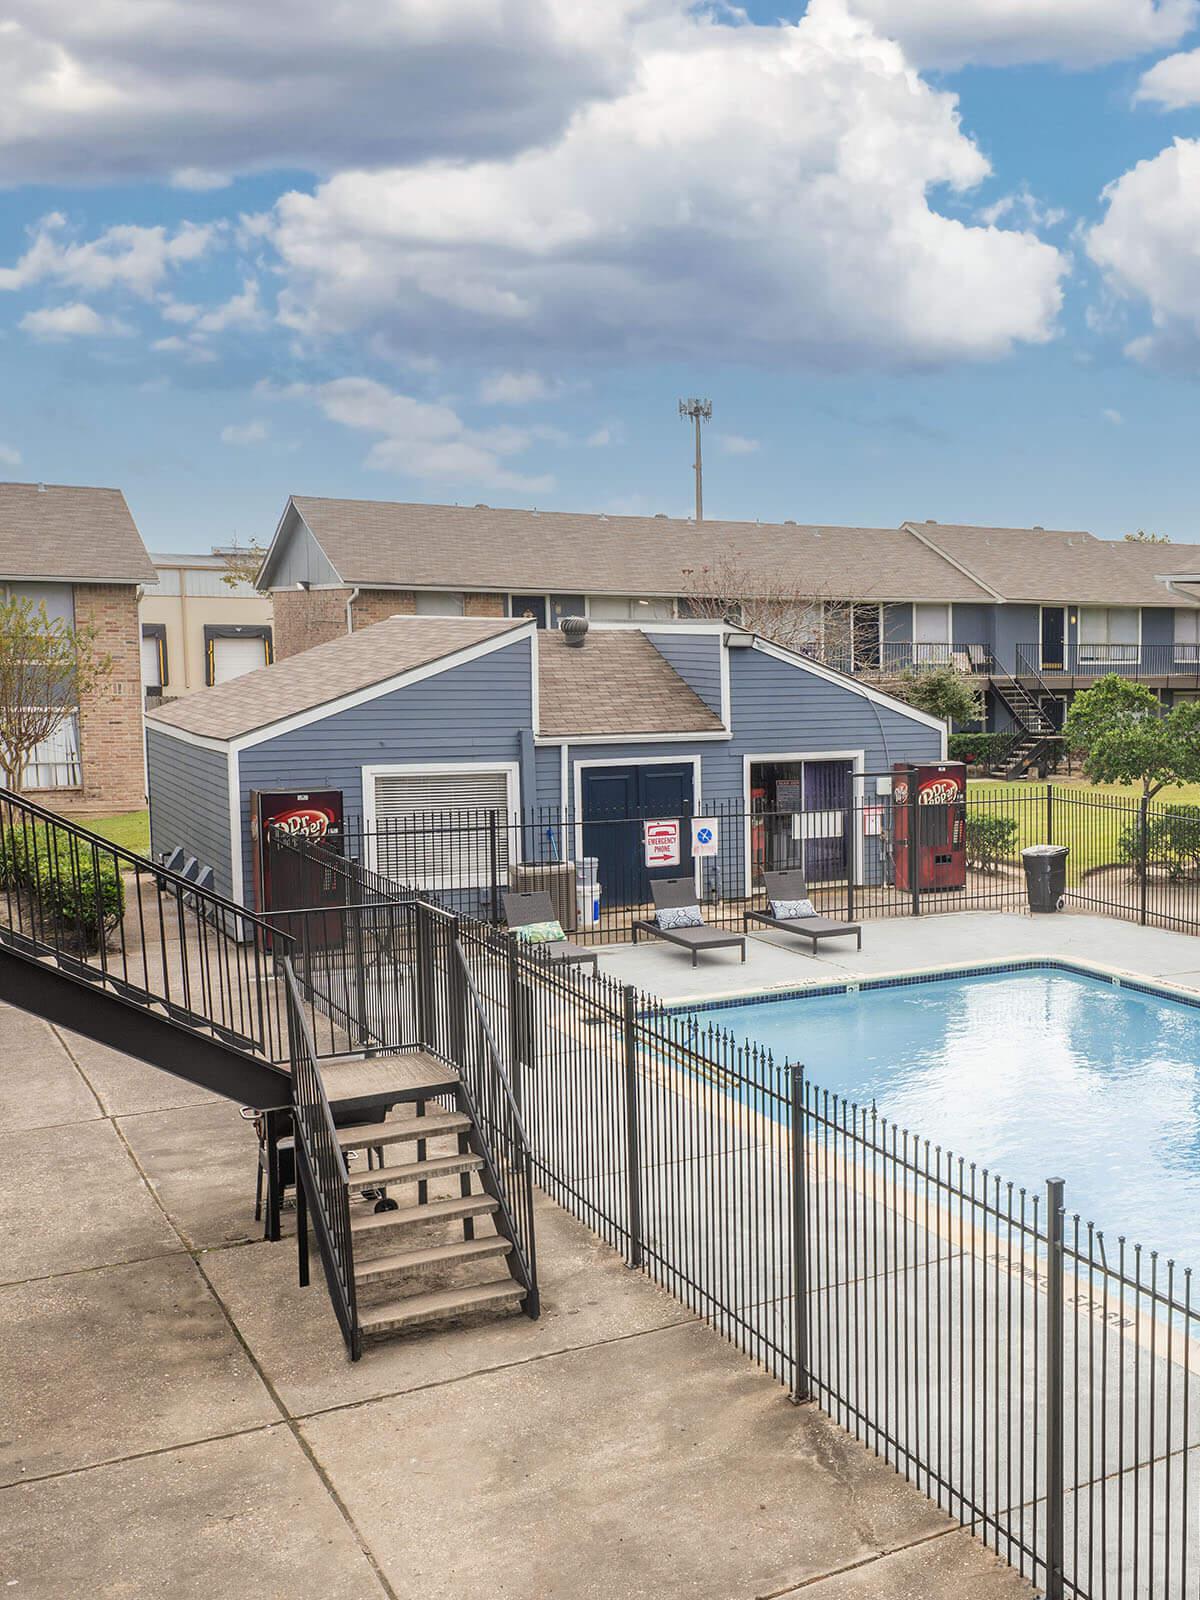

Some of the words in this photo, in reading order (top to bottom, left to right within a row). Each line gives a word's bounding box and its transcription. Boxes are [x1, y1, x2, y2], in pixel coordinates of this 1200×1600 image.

[931, 783, 947, 796] Dr
[287, 815, 310, 833] Dr
[647, 836, 677, 846] EMERGENCY
[654, 845, 671, 853] PHONE
